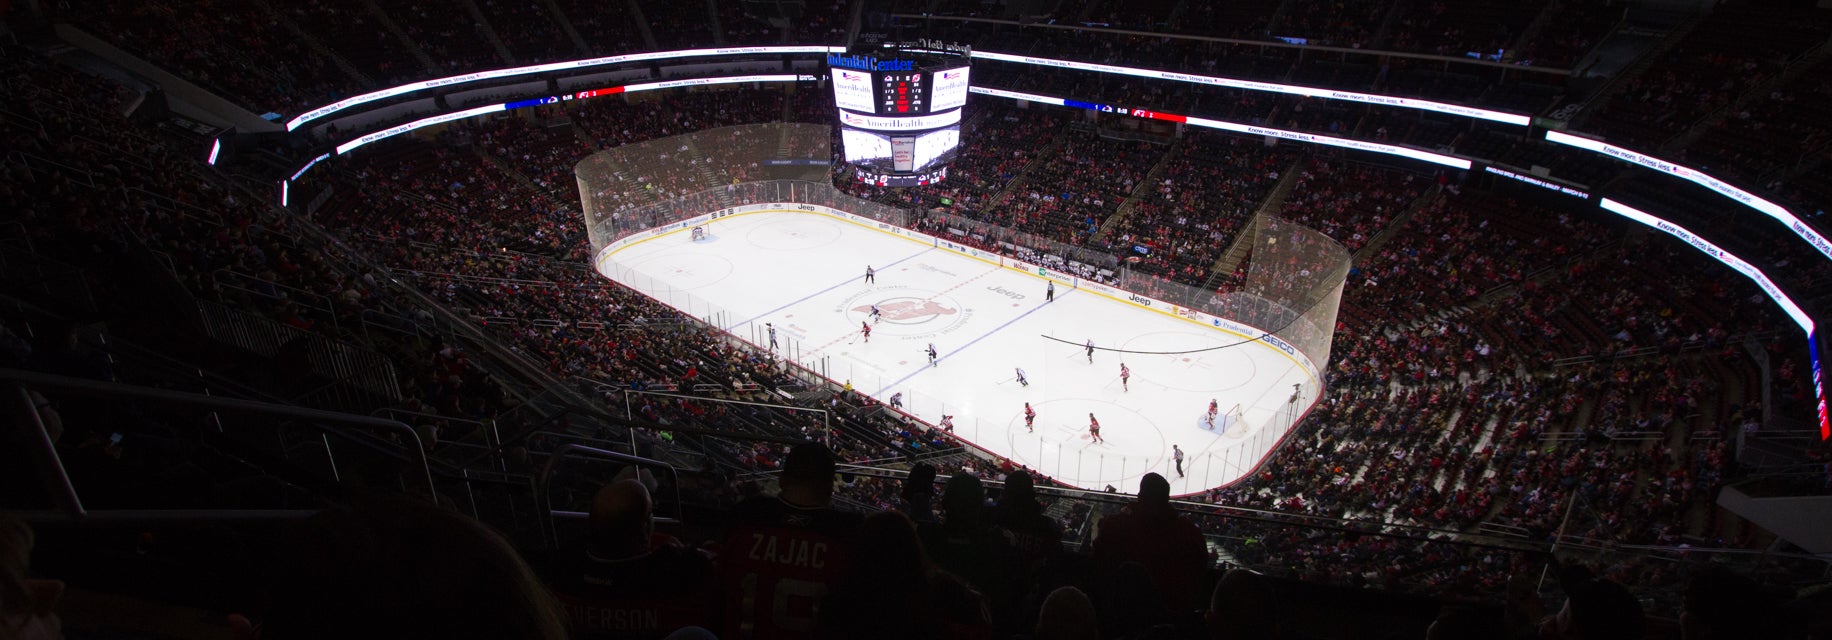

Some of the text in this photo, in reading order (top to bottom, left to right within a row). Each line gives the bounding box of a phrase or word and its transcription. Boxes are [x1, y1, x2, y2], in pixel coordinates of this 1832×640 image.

[870, 57, 914, 71] Center
[867, 119, 923, 128] AmeriHealth
[1603, 146, 1670, 172] Know more. Stress less.
[1657, 221, 1718, 257] Know more. Stress less.
[1013, 262, 1029, 272] Wawa
[987, 286, 1025, 300] Jeep
[1129, 293, 1151, 307] Jeep
[1222, 322, 1253, 336] Prudential
[1261, 334, 1294, 355] GEICO
[749, 533, 827, 569] ZAJAC
